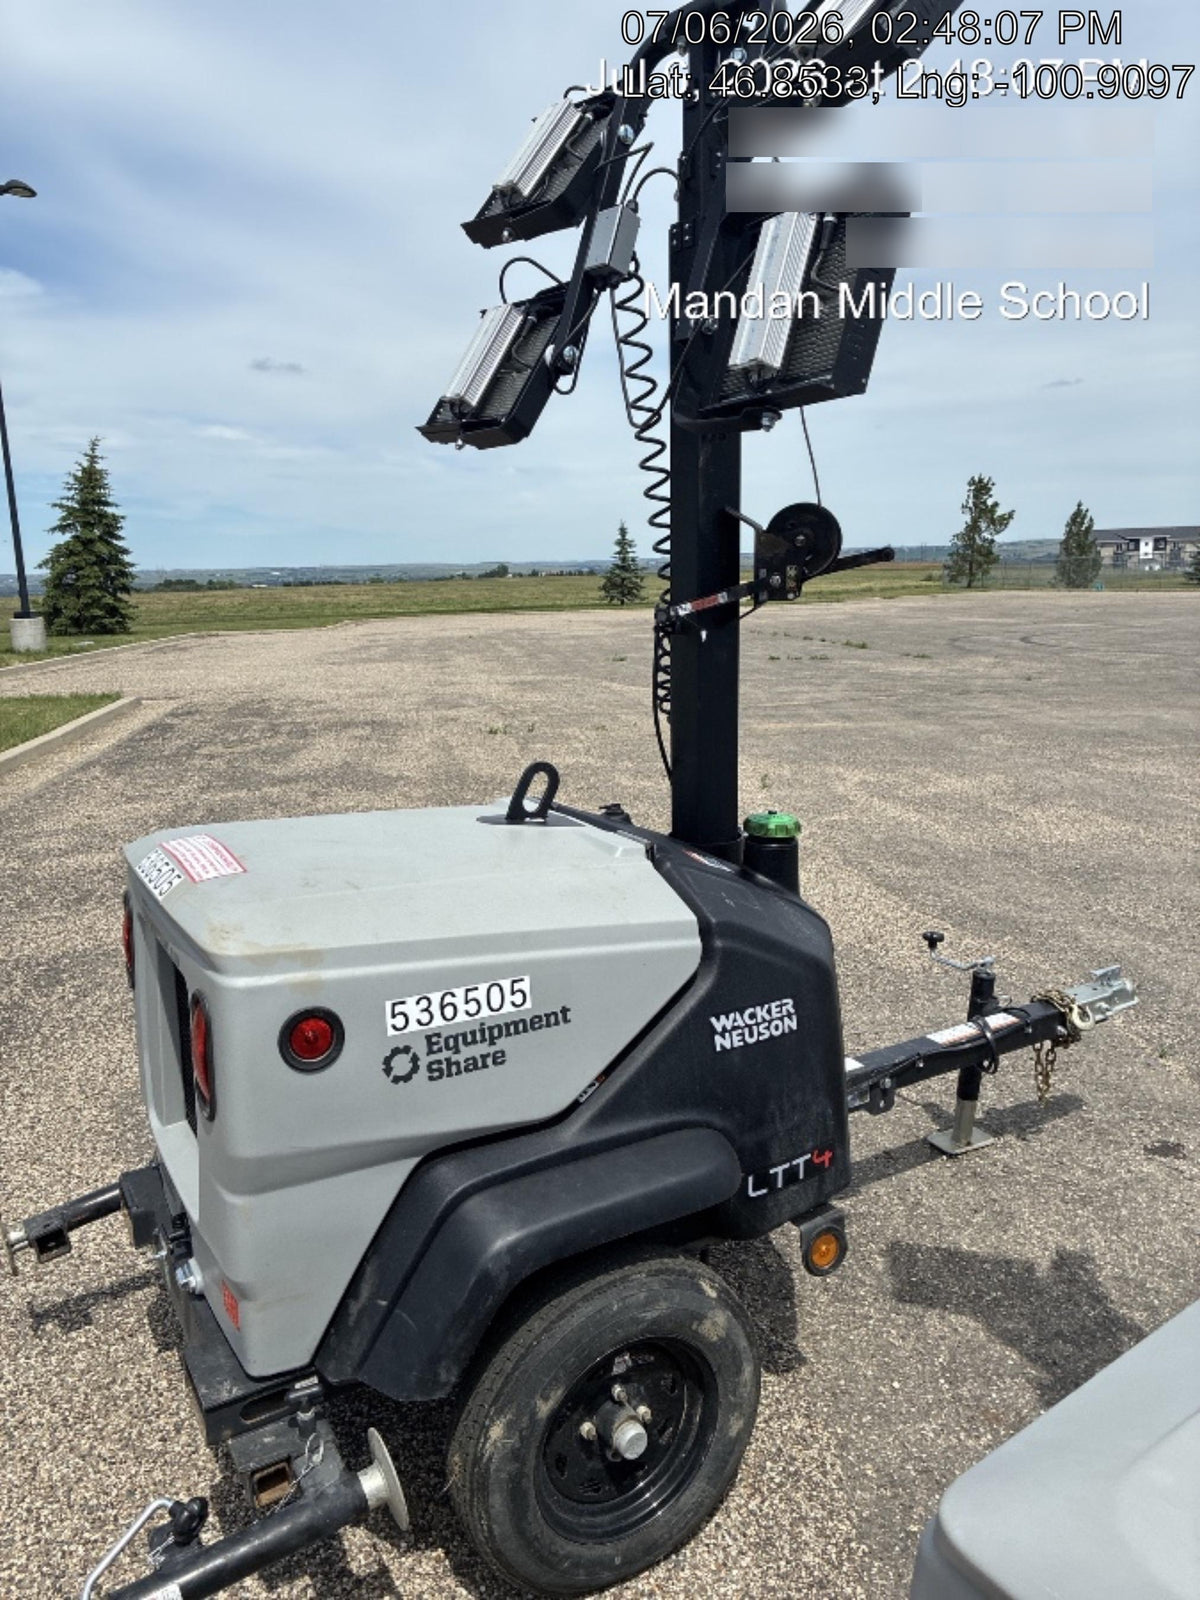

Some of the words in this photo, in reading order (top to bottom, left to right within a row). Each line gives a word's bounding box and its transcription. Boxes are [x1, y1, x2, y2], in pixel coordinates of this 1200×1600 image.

[390, 978, 528, 1032] 536505
[710, 998, 796, 1034] WACKER
[425, 1005, 572, 1055] Equipment
[714, 1014, 798, 1052] NEUSON
[426, 1048, 507, 1081] Share
[748, 1150, 833, 1198] LTT4
